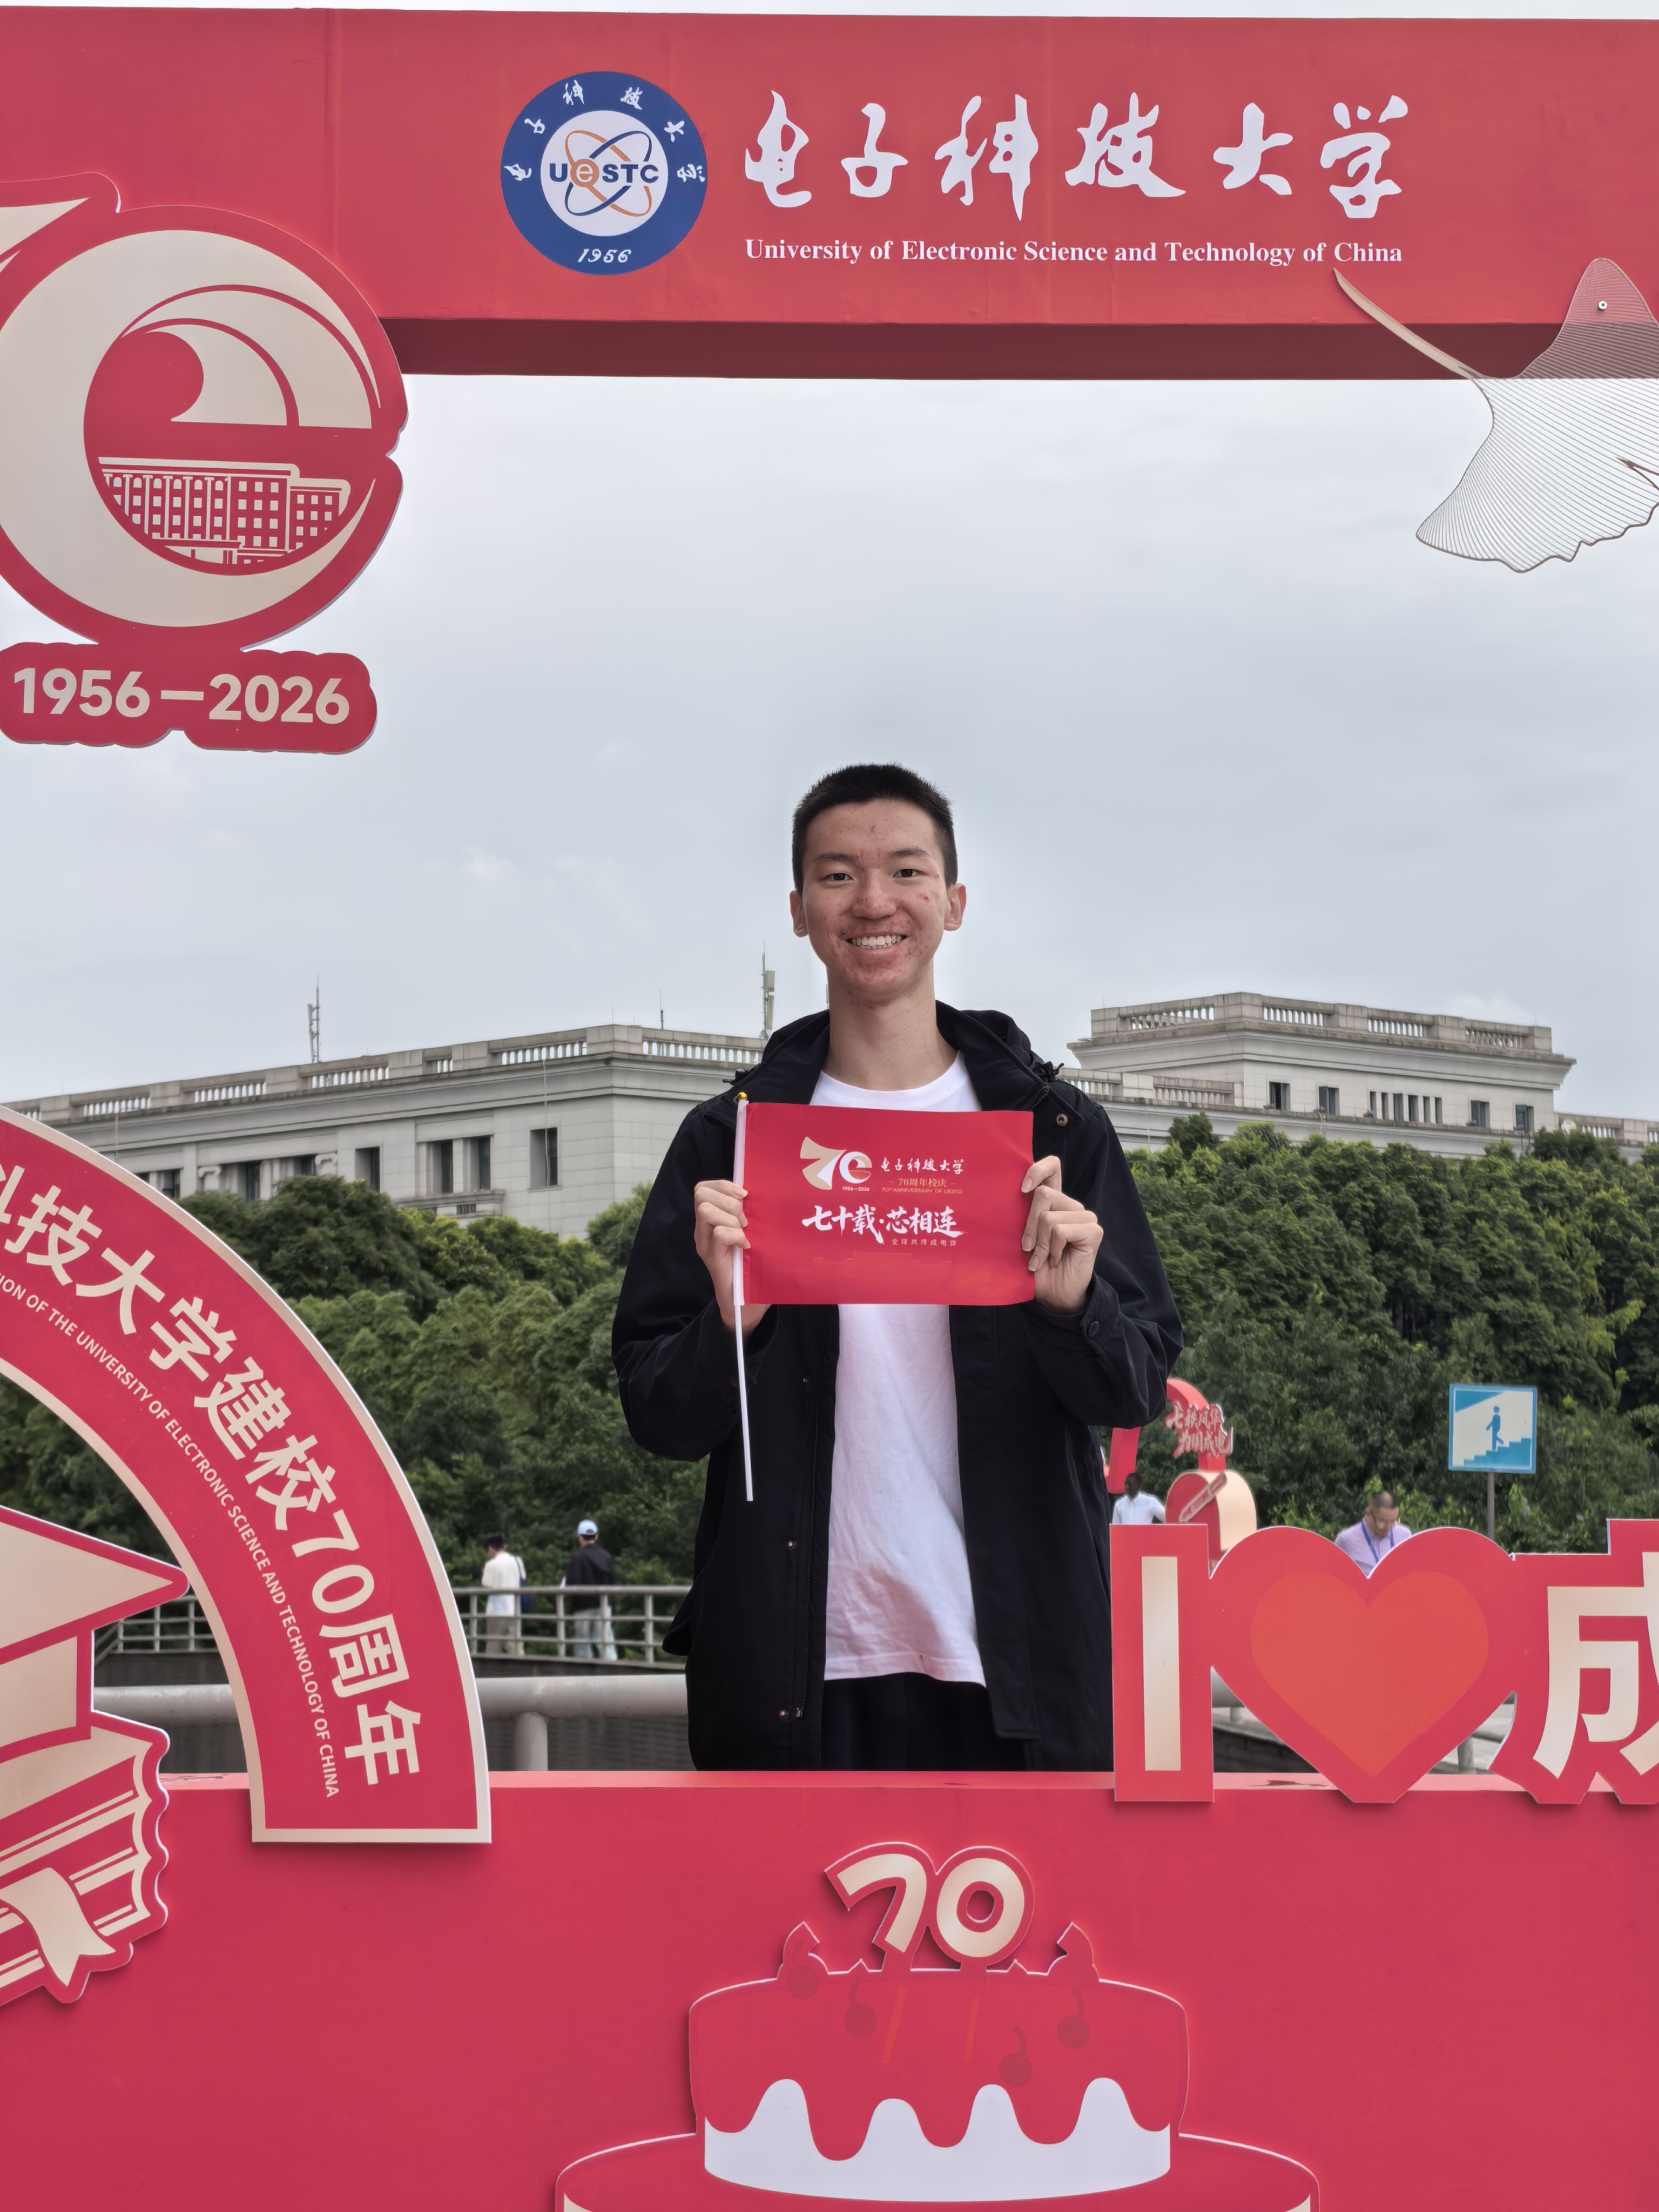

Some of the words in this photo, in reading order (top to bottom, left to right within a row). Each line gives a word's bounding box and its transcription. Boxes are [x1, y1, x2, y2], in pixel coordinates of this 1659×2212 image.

[745, 90, 1408, 218] 电子科技大学
[577, 248, 632, 264] 1956
[745, 239, 862, 265] University
[870, 240, 894, 260] of
[902, 240, 1017, 260] Electronic
[1024, 241, 1108, 261] Science
[1115, 242, 1157, 261] and
[1164, 242, 1296, 267] Technology
[1303, 242, 1327, 261] of
[1333, 242, 1402, 262] China
[881, 1157, 964, 1175] 电子科技大学
[0, 1272, 26, 1300] ION
[26, 1294, 49, 1312] OF
[48, 1307, 78, 1337] THE
[76, 1330, 153, 1402] UNIVERSITY
[149, 1400, 171, 1420] OF
[165, 1419, 234, 1507] ELECTRONIC
[227, 1505, 271, 1571] SCIENCE
[262, 1572, 286, 1604] AND
[279, 1604, 325, 1714] TECHNOLOGY
[1141, 1556, 1181, 1771] I
[314, 1718, 331, 1740] OF
[319, 1743, 340, 1798] CHINA
[837, 1853, 1024, 1958] 70
